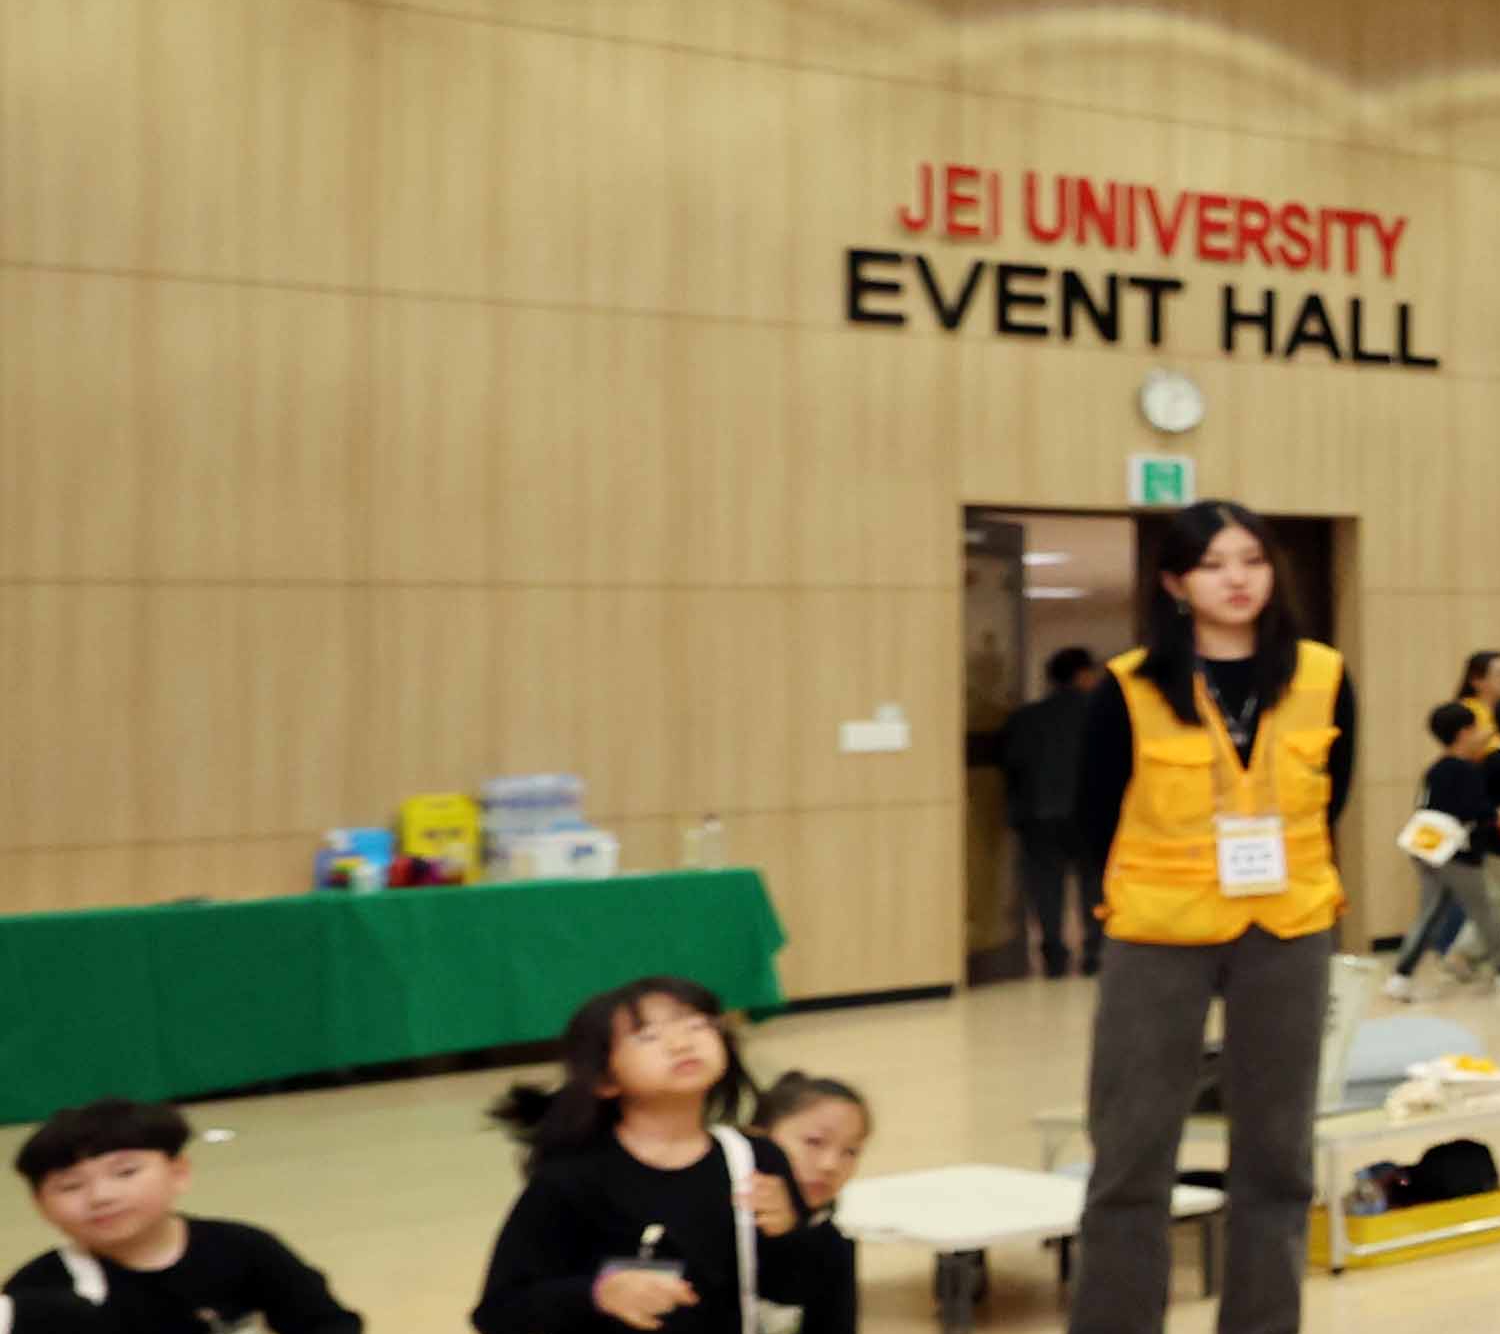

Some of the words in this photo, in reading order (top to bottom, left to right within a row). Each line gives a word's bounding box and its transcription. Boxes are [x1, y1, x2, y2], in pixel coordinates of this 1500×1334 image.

[900, 162, 1002, 239] JEI
[1024, 170, 1407, 277] UNIVERSITY
[845, 246, 1183, 349] EVENT
[1220, 281, 1440, 369] HALL
